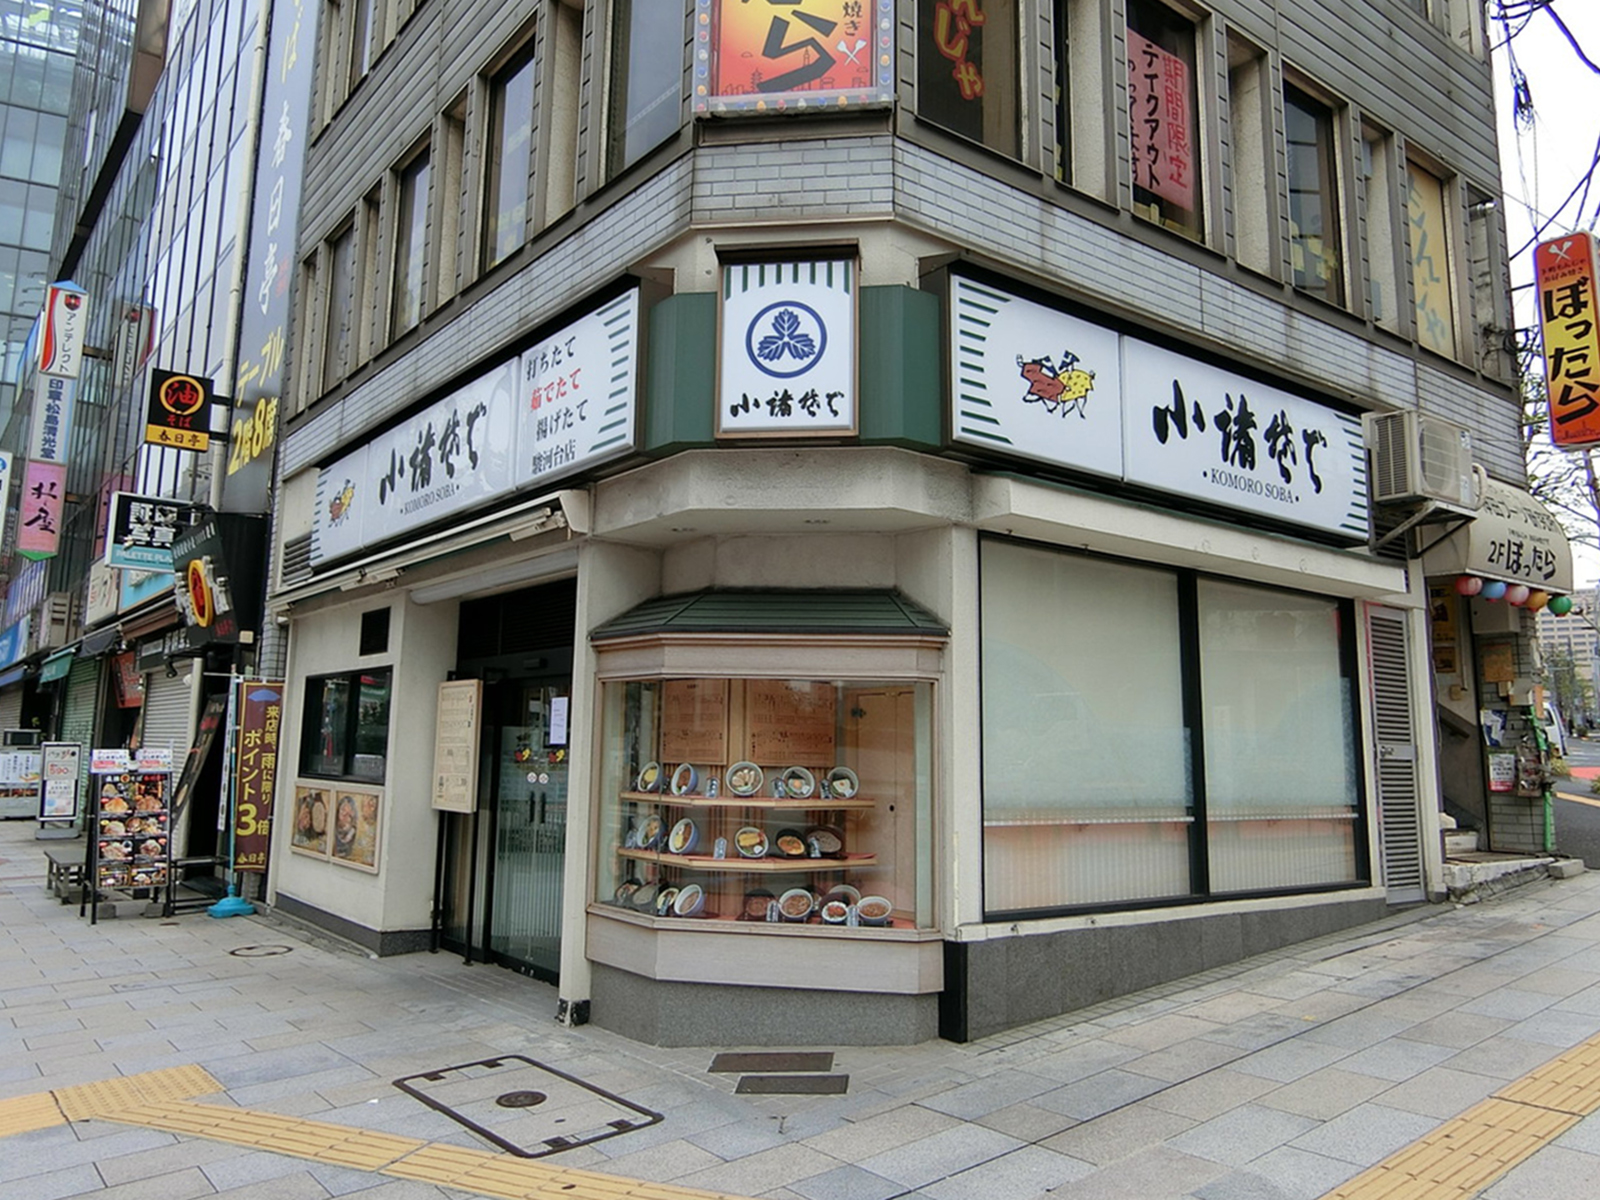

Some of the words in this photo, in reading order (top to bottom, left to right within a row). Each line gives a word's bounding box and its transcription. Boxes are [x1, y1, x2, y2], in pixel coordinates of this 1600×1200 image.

[842, 0, 863, 37] 焼き
[741, 0, 838, 93] ら
[1142, 43, 1160, 189] テイクアウト
[1163, 53, 1189, 189] 期間限定
[526, 335, 577, 382] 打ちたて
[1543, 276, 1600, 426] ぼったら
[166, 382, 199, 405] 油
[159, 429, 200, 447] 春日亭
[167, 414, 192, 428] そば
[536, 398, 588, 442] 揚げたて
[532, 439, 577, 475] 駿河台店
[1211, 468, 1264, 494] KOMORO
[1264, 483, 1294, 504] SOBA
[154, 554, 175, 564] PLA
[1487, 541, 1505, 564] 2F
[1506, 539, 1557, 581] ぼったら
[236, 729, 269, 836] ポイント3倍
